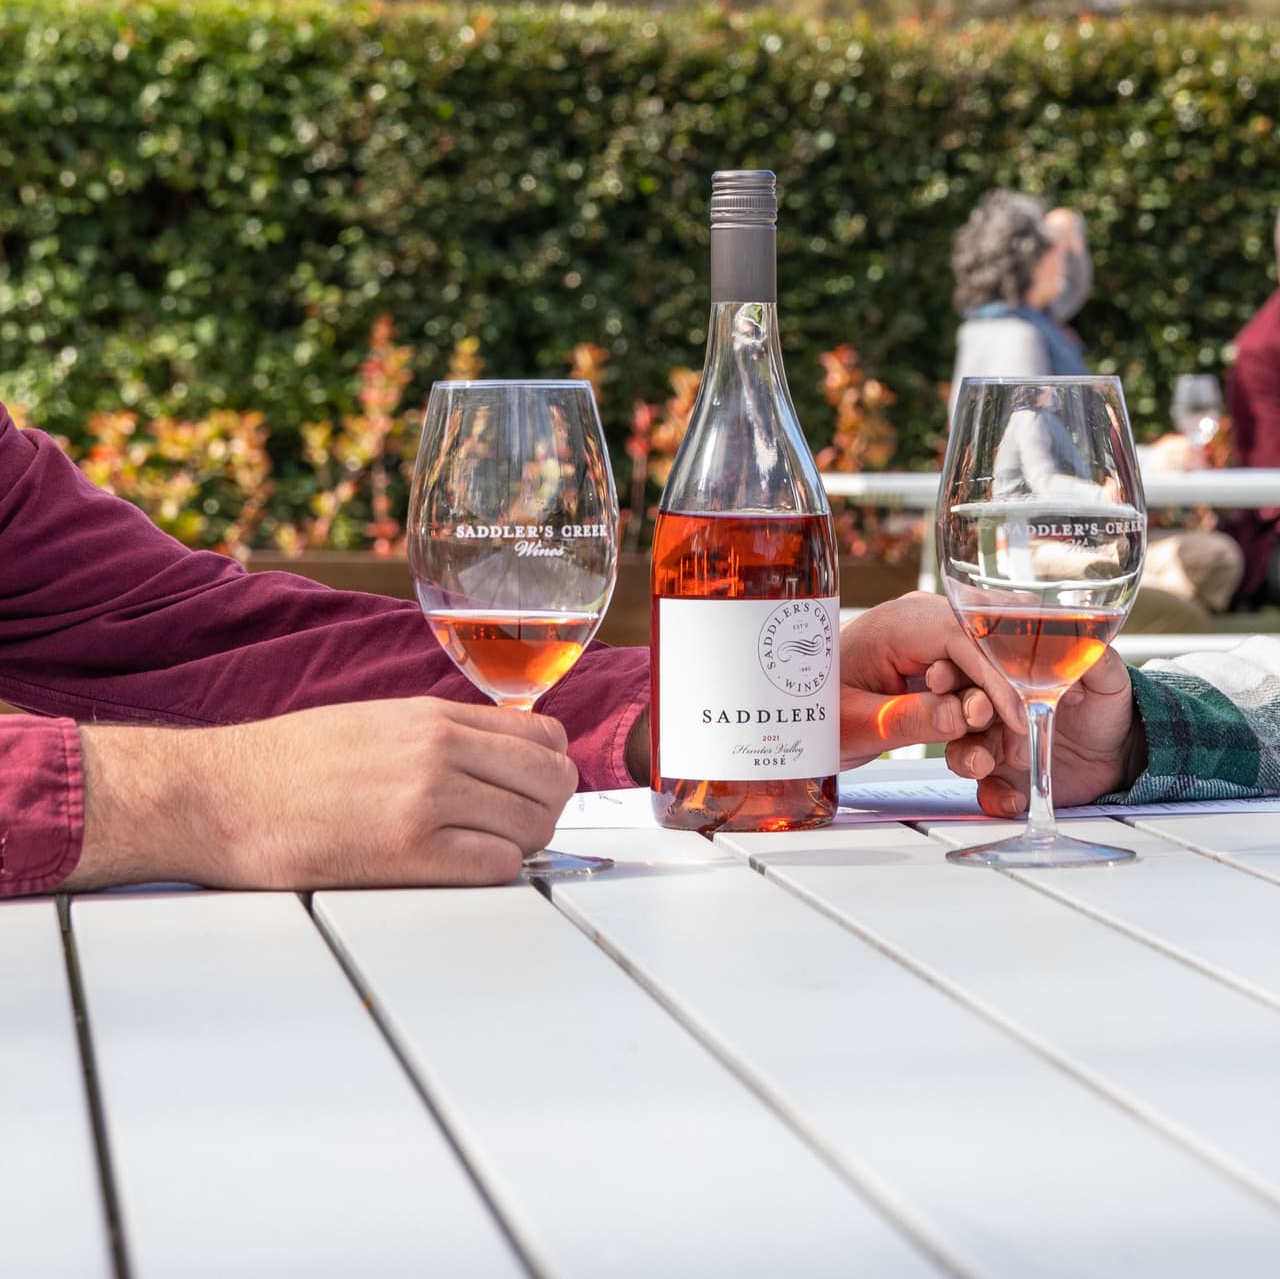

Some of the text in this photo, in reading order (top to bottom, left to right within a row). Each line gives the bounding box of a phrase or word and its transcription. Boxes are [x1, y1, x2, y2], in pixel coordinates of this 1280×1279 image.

[455, 524, 608, 538] SADDLER'S CREEK
[514, 540, 566, 558] Wines
[763, 601, 831, 670] SADDLER'S CREEK
[785, 671, 825, 692] WINES
[702, 703, 826, 723] SADDLER'S
[732, 739, 804, 761] Hunter Valley
[754, 754, 786, 766] ROSÉ
